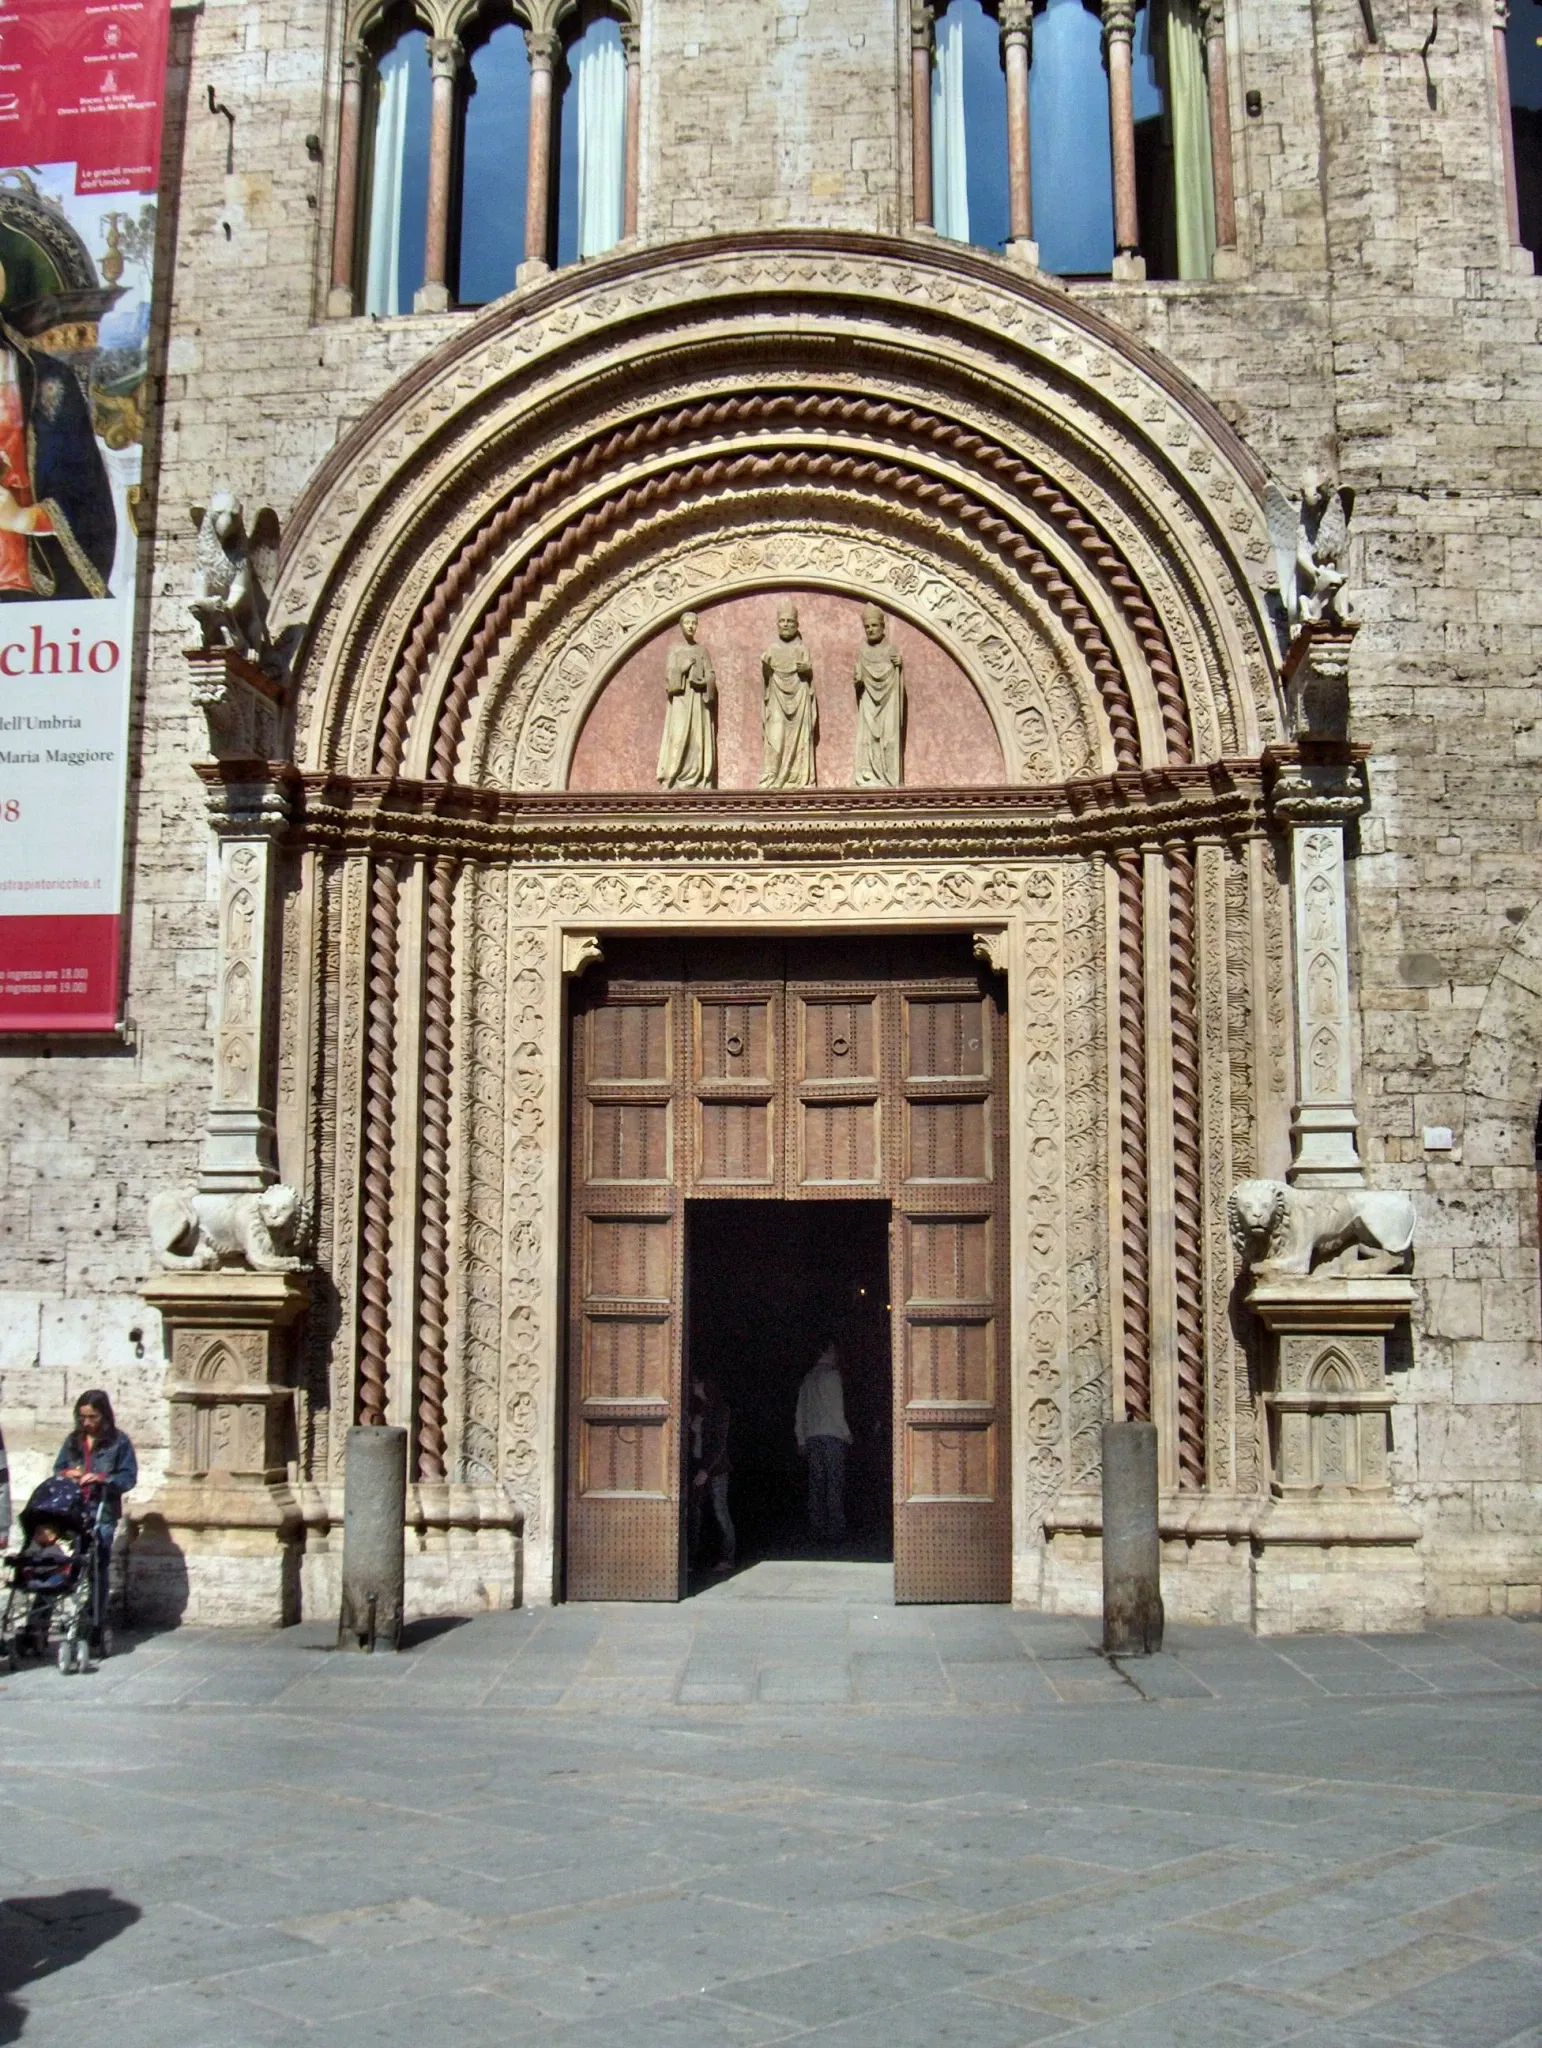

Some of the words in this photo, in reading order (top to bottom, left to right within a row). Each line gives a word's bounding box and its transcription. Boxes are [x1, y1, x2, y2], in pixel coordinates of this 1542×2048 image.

[81, 169, 93, 178] Le
[93, 166, 121, 179] grandi
[122, 166, 153, 175] mostre
[80, 177, 131, 189] dell'Umbria
[0, 750, 40, 764] Maria
[46, 749, 115, 766] Maggiore
[0, 799, 20, 822] 8
[44, 970, 59, 979] ore
[43, 984, 57, 993] ore
